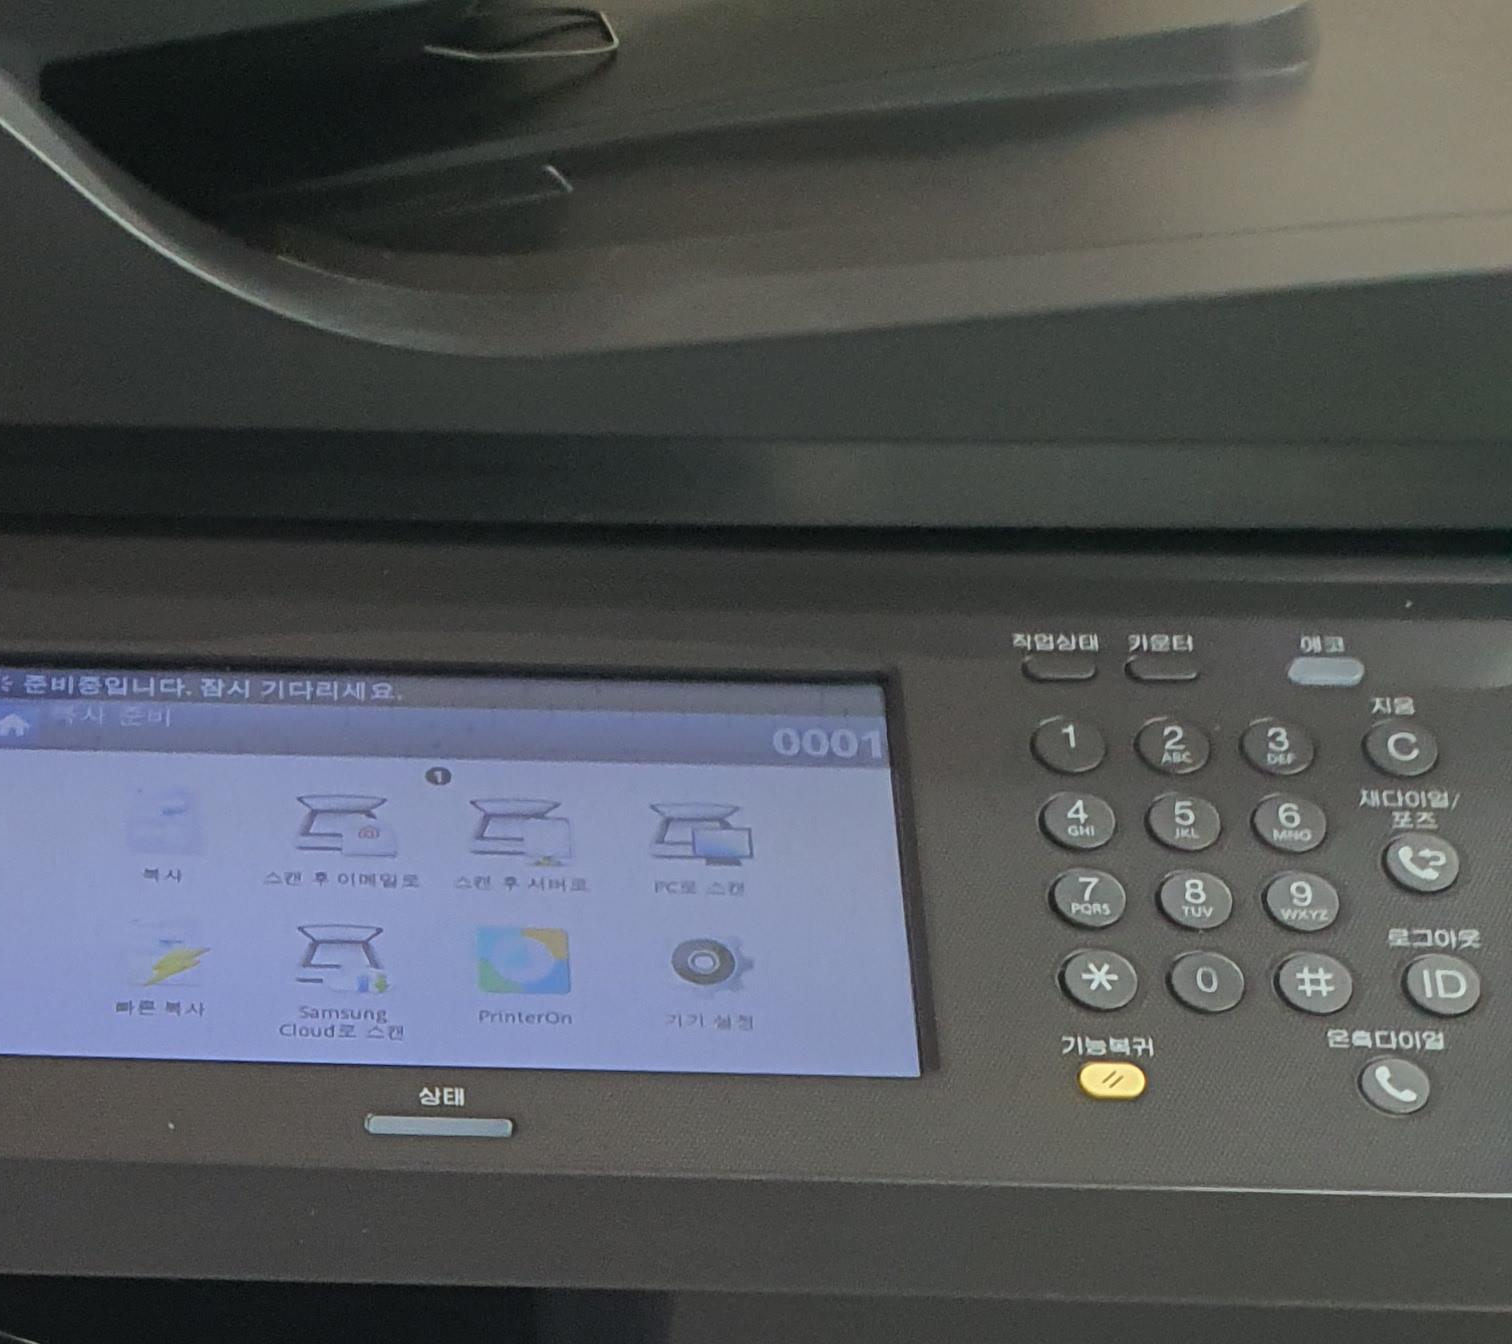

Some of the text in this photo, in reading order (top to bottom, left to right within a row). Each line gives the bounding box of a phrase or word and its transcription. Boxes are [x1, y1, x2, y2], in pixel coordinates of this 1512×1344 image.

[1128, 633, 1194, 653] 카운터
[1300, 635, 1345, 653] 에코
[23, 674, 403, 701] 준비중입니다. 잠시 기다리세요.
[772, 728, 882, 758] 0001
[1061, 725, 1076, 748] 1
[1163, 725, 1186, 750] 2
[1267, 727, 1289, 752] 3
[1387, 732, 1419, 761] C
[1161, 751, 1193, 765] ABC
[1267, 752, 1296, 765] DEF
[1067, 799, 1089, 824] 4
[1174, 801, 1195, 826] 5
[1278, 803, 1301, 828] 6
[1068, 825, 1095, 837] GHI
[1174, 827, 1199, 840] JKL
[1078, 877, 1099, 901] 7
[1184, 879, 1206, 904] 8
[1290, 881, 1313, 907] 9
[1071, 902, 1111, 916] PQRS
[1181, 906, 1215, 918] TUV
[1280, 908, 1329, 922] WXYZ
[1388, 928, 1481, 949] 로그아웃
[1196, 967, 1218, 993] 0
[1423, 970, 1467, 999] ID
[299, 1005, 388, 1023] Samsung
[478, 1009, 573, 1025] PrinterOn
[279, 1023, 357, 1039] Cloud로
[1061, 1036, 1154, 1058] 기능복귀
[418, 1086, 465, 1107] 상태
